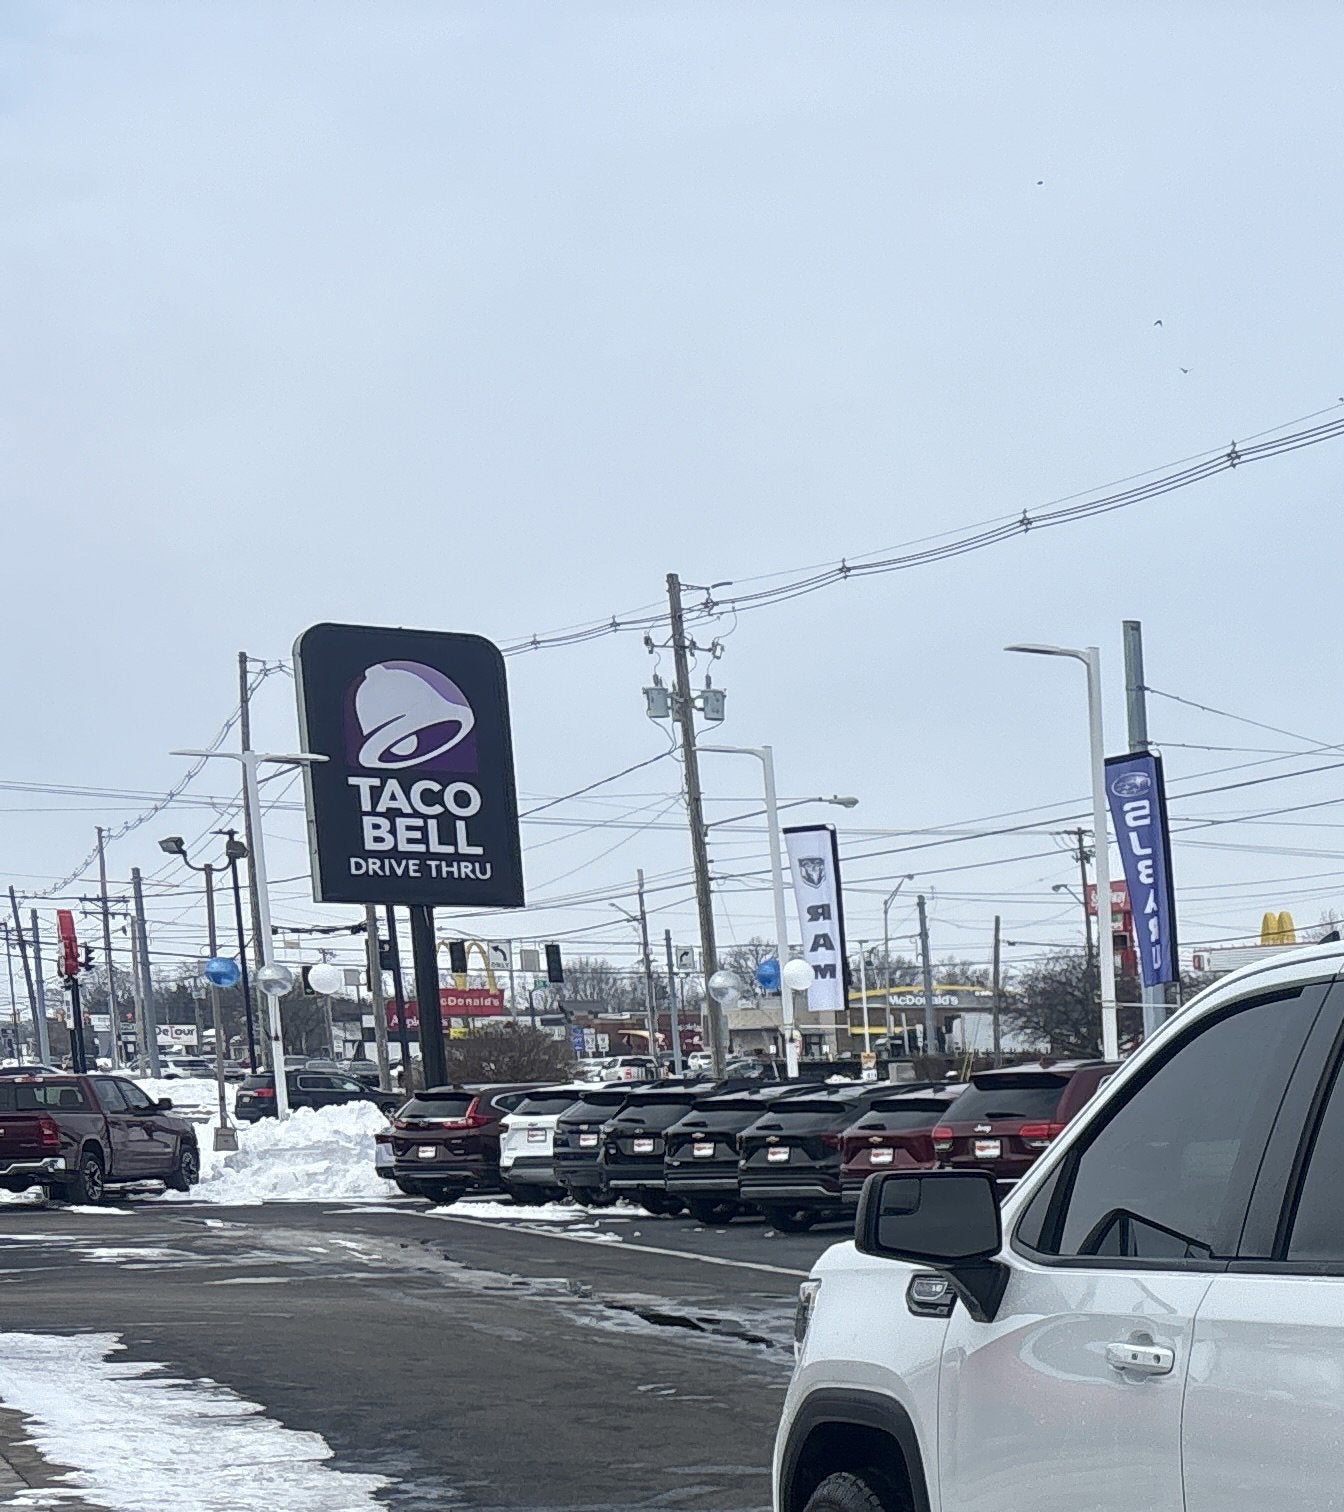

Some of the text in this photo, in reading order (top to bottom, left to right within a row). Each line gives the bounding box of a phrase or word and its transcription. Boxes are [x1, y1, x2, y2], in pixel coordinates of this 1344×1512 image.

[347, 777, 482, 817] TACO
[361, 815, 484, 855] BELL
[350, 857, 491, 879] DRIVE THRU
